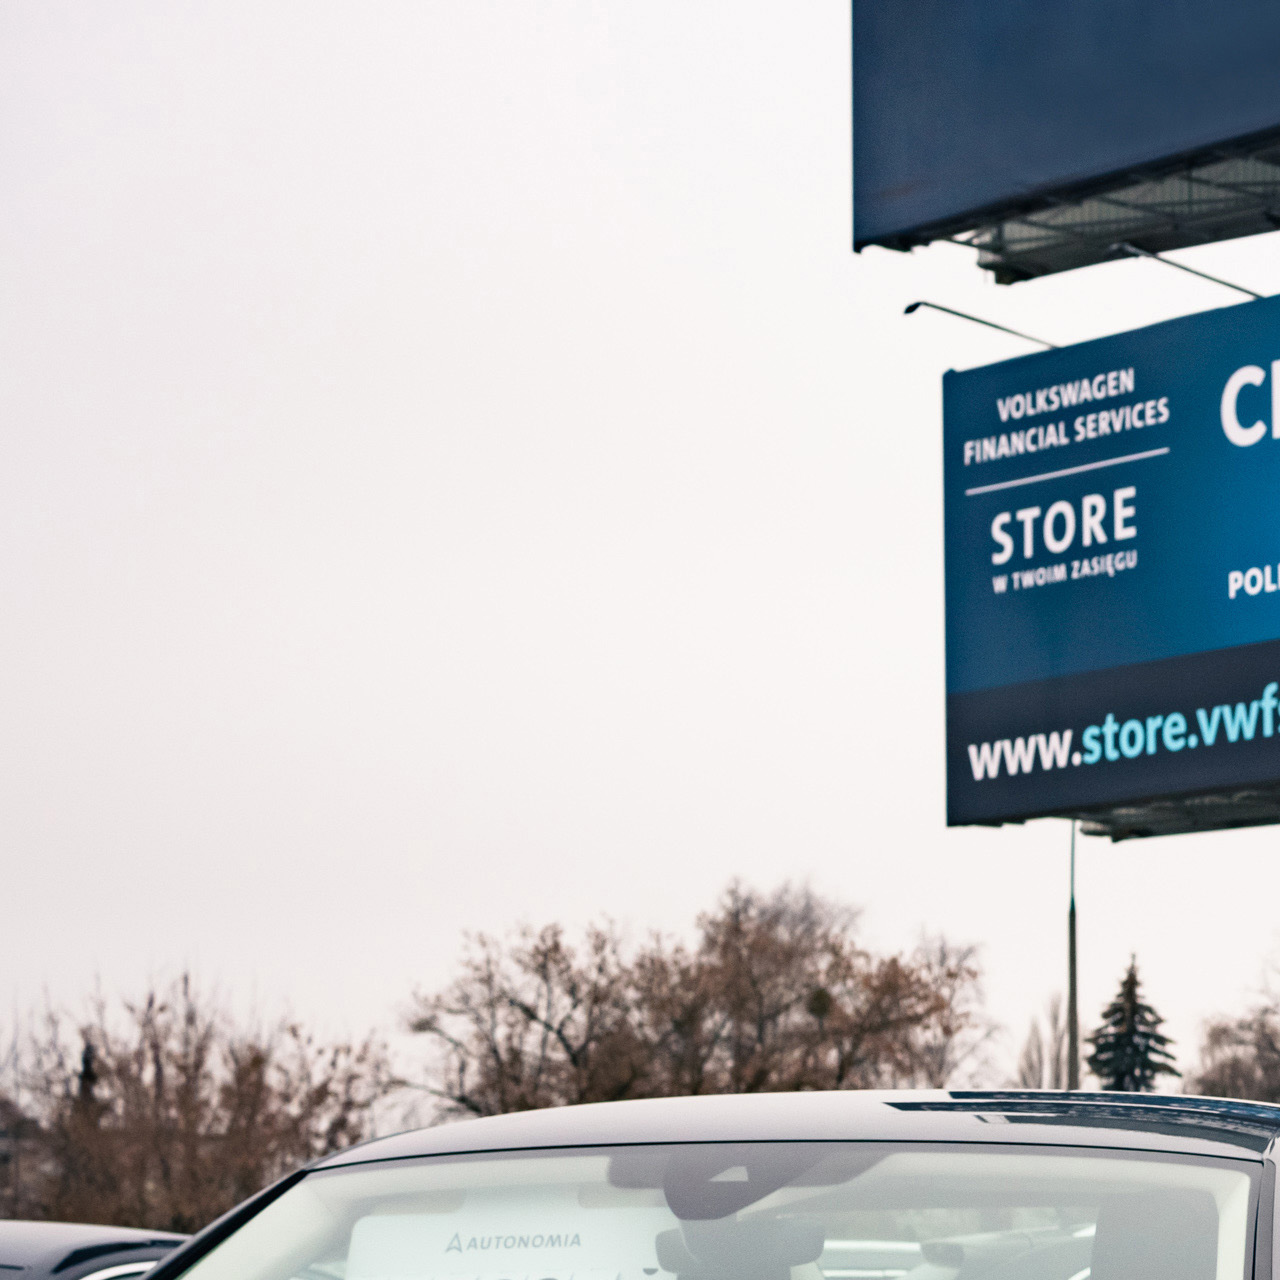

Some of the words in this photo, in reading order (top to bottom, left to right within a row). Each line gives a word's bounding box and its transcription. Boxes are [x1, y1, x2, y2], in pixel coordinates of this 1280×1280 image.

[997, 367, 1135, 422] VOLKSWAGEN
[964, 421, 1070, 466] FINANCIAL
[1074, 397, 1170, 442] SERVICES
[990, 486, 1137, 565] STORE
[992, 574, 1008, 594] W
[1012, 563, 1068, 590] TWOIM
[1070, 550, 1138, 577] ZASIĘGU
[466, 1232, 582, 1251] AUTONOMIA
